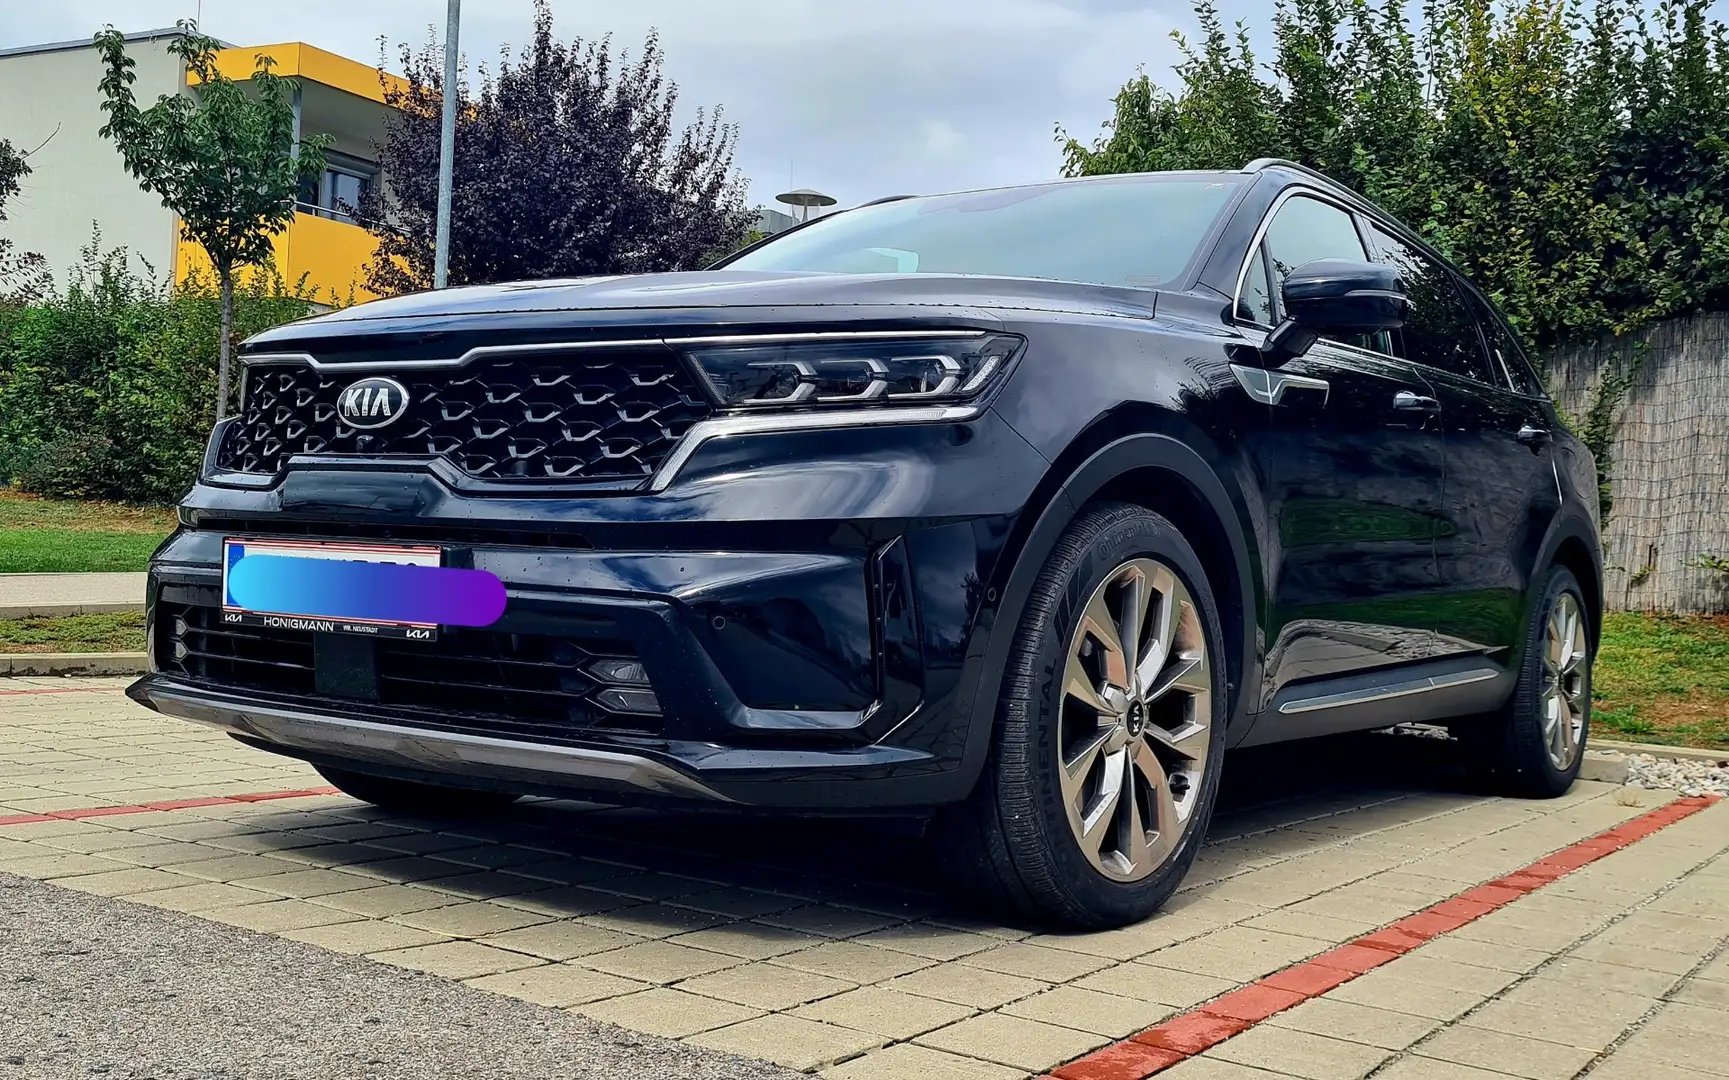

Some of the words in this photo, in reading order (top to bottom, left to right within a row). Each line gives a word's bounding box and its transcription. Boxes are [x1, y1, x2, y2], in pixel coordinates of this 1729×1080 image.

[344, 387, 392, 417] KIA
[224, 613, 243, 623] KIA
[263, 615, 335, 632] HONIGMANN
[406, 628, 430, 639] KIA
[1132, 704, 1140, 733] KIA
[1037, 658, 1078, 881] NTINENTAL
